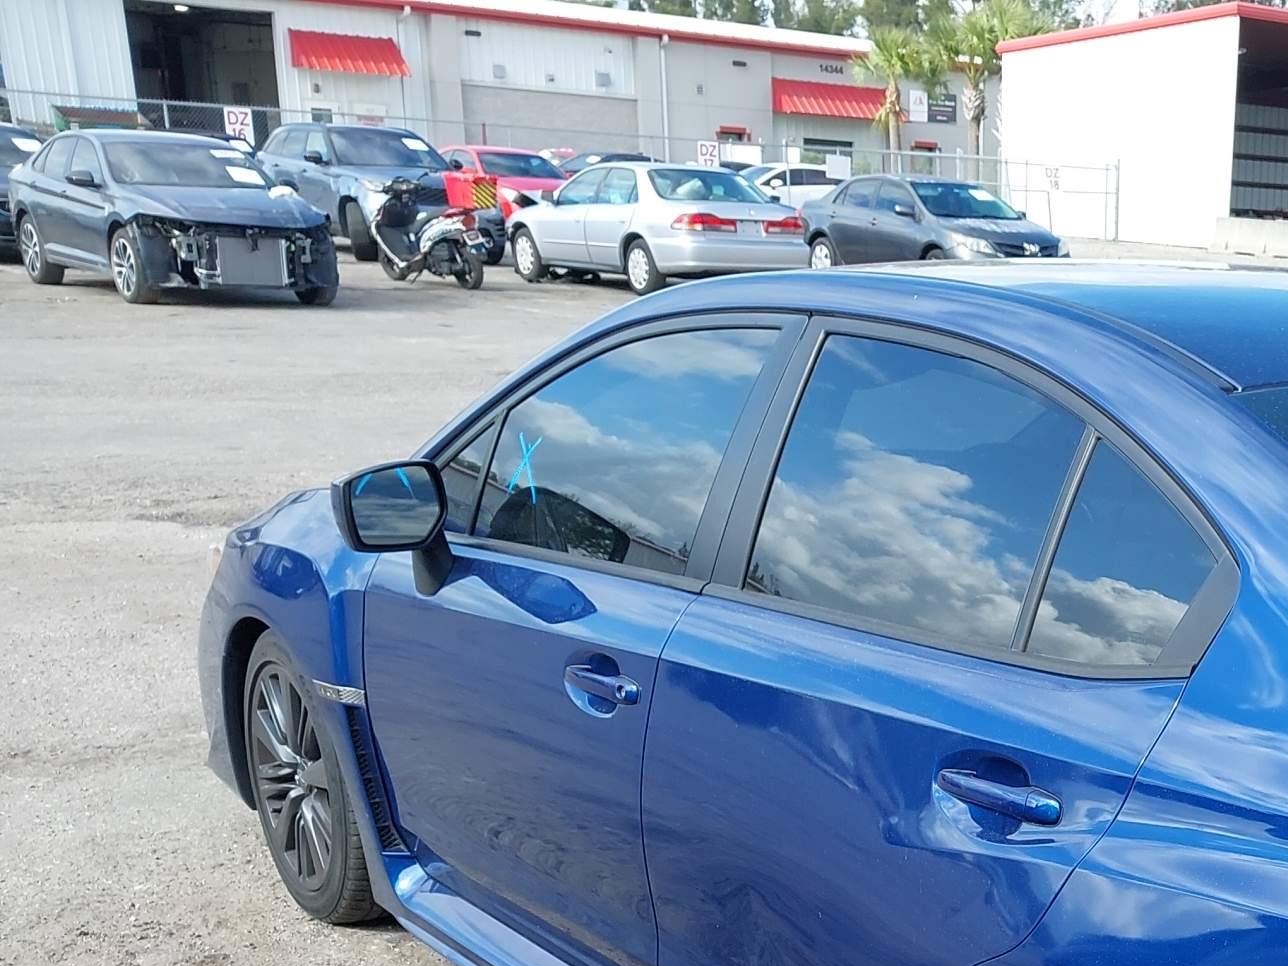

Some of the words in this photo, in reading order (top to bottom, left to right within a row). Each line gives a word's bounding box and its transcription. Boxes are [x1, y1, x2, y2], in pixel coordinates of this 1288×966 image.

[227, 110, 250, 126] DZ
[231, 128, 247, 139] 16
[700, 143, 717, 157] DZ
[1045, 168, 1060, 178] DZ
